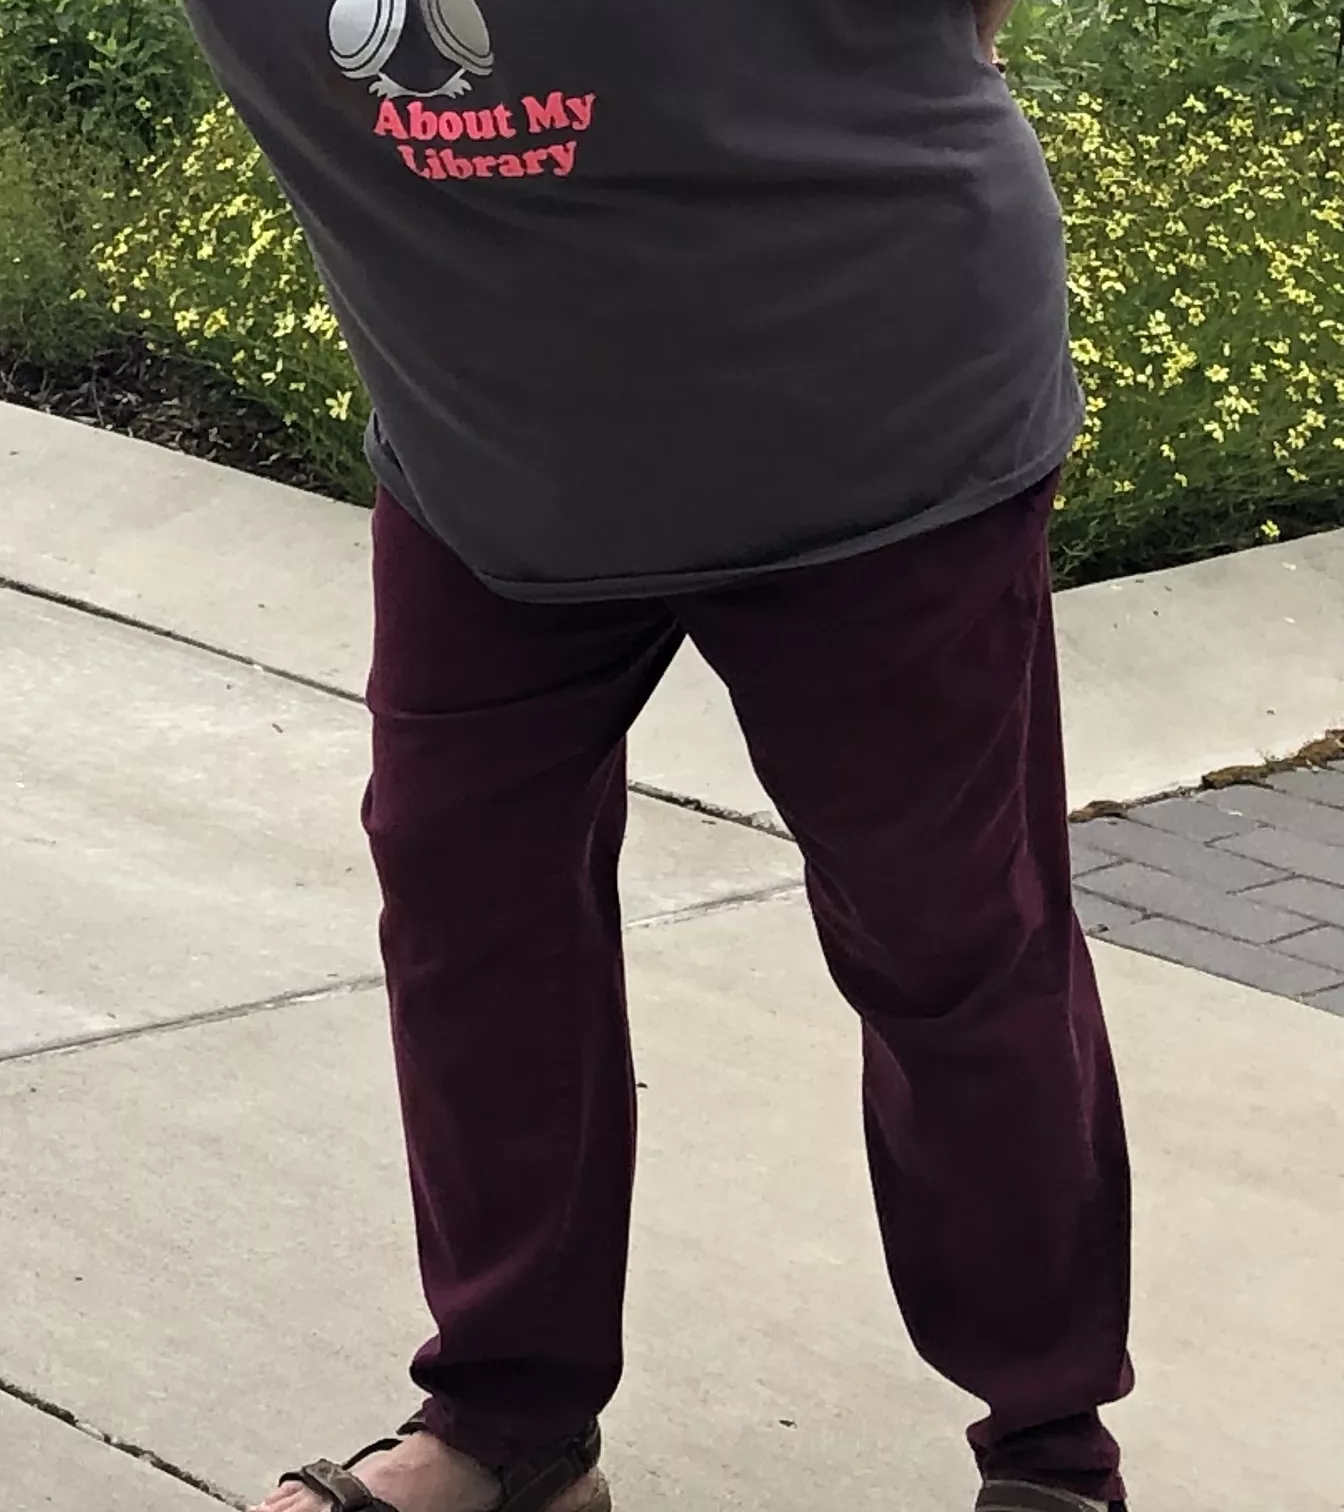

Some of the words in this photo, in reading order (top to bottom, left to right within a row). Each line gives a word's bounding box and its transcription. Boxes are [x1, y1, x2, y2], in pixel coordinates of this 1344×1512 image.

[373, 96, 516, 141] About
[521, 91, 597, 134] My
[397, 140, 578, 180] Library
